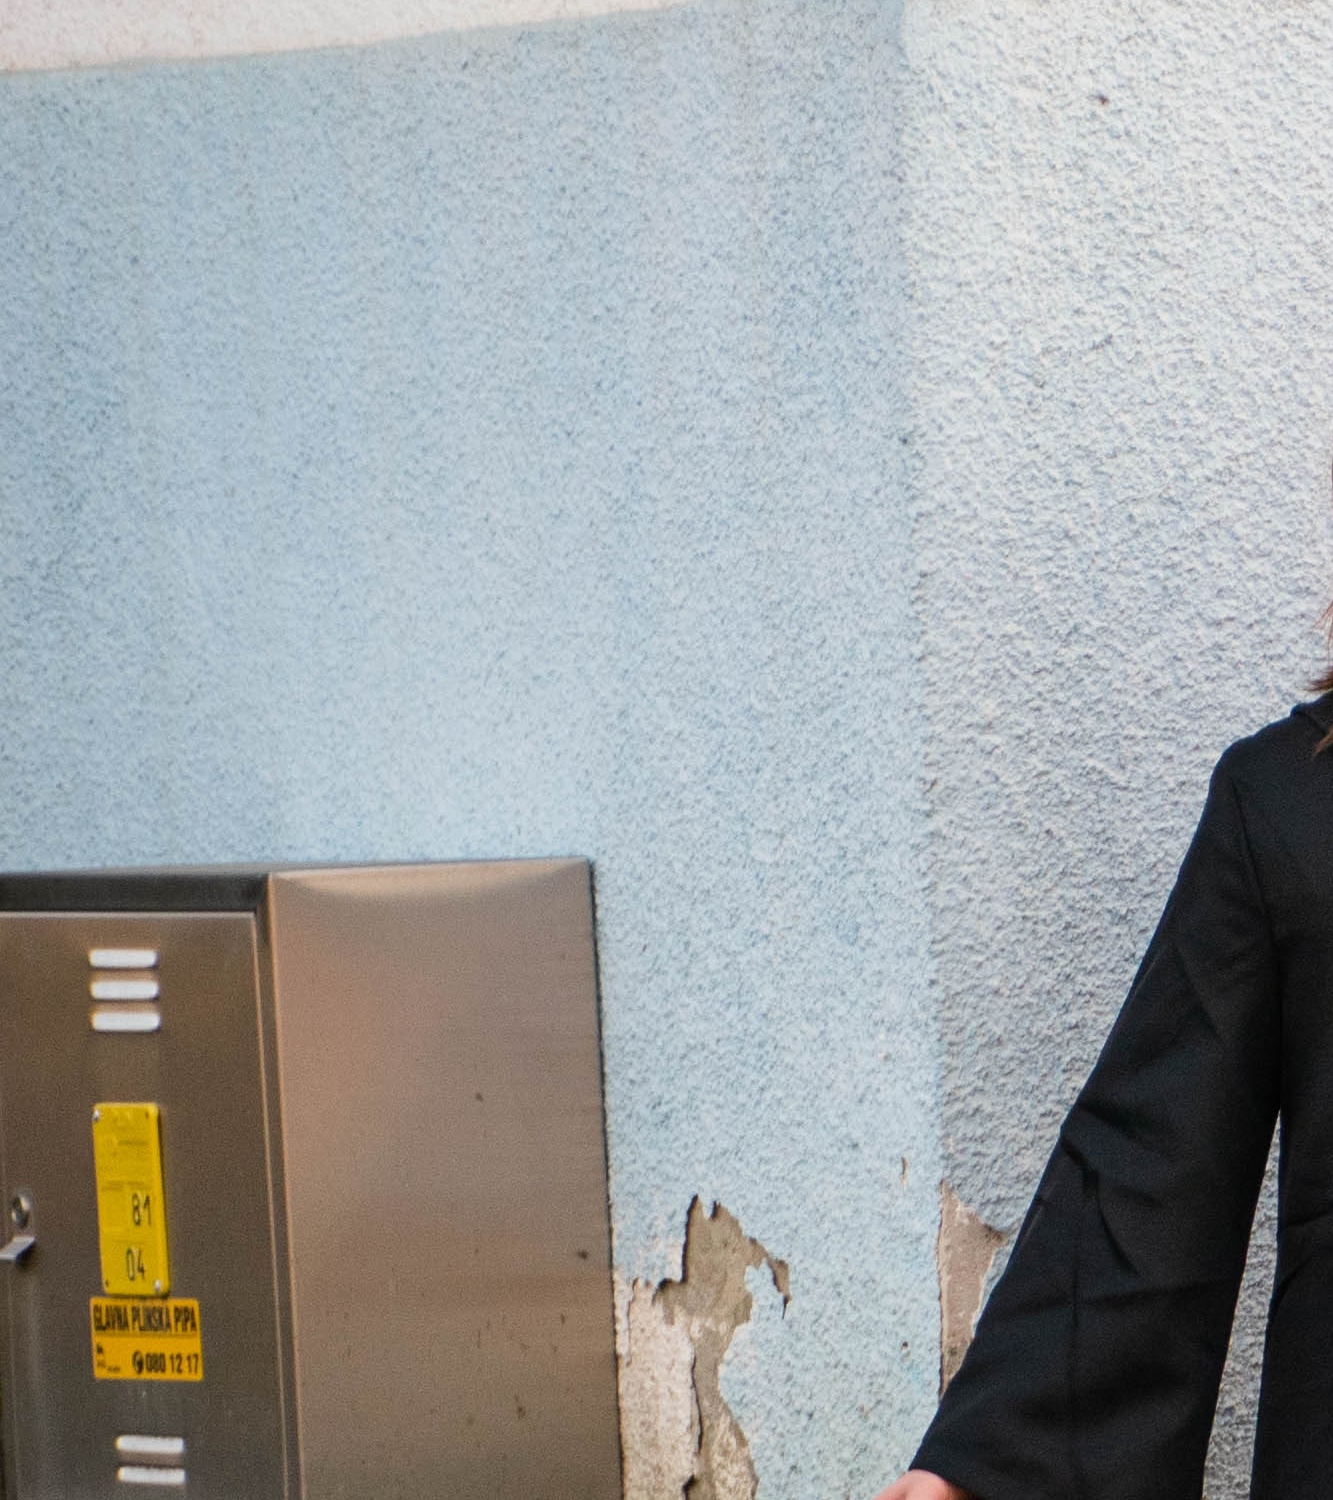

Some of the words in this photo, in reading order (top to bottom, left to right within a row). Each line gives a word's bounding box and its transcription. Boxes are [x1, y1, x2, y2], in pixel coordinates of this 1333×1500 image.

[131, 1189, 152, 1227] 81
[126, 1246, 145, 1281] 04
[93, 1304, 129, 1331] GLAVNA
[174, 1305, 197, 1332] PIPA
[145, 1352, 167, 1374] 080
[169, 1352, 183, 1375] 12
[186, 1352, 199, 1375] 17
